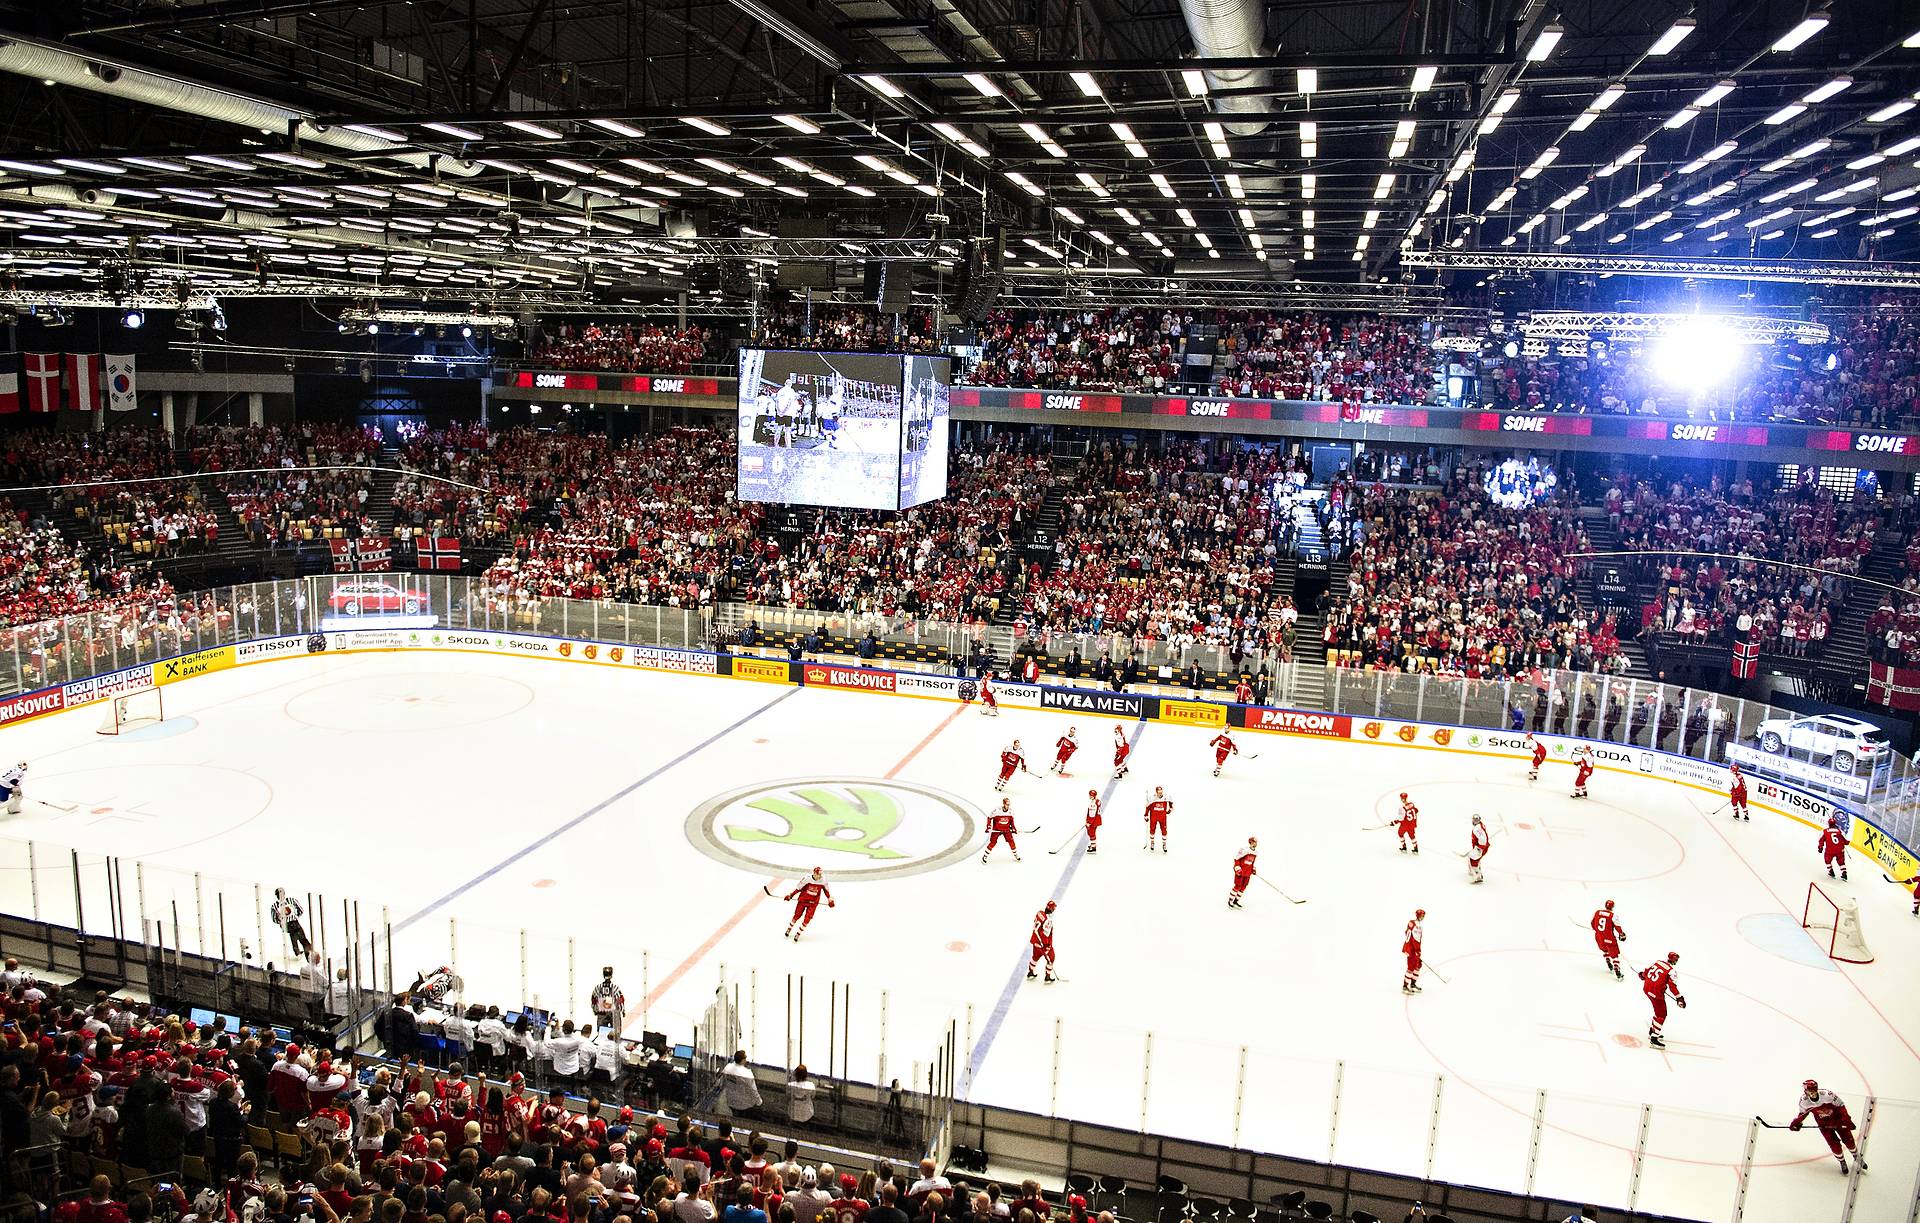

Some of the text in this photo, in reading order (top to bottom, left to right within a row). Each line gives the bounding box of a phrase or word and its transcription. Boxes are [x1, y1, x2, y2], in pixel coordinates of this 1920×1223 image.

[536, 374, 566, 388] SOME
[653, 379, 684, 392] SOME
[1046, 396, 1082, 410] SOME
[1190, 402, 1229, 416] SOME
[1503, 416, 1546, 432] SOME
[1672, 424, 1716, 441] SOME
[1856, 435, 1907, 453] SOME
[1306, 554, 1321, 562] L13
[1604, 575, 1620, 583] L14
[257, 639, 302, 652] TISSOT
[182, 650, 224, 664] Raiffeisen
[183, 663, 208, 676] BANK
[738, 662, 783, 677] PIRELLI
[97, 673, 122, 688] LIQUI
[127, 676, 152, 690] MOLY
[830, 669, 893, 689] KRUŠOVICE
[915, 680, 954, 689] TISSOT
[67, 681, 93, 696] LIQUI
[98, 684, 124, 698] MOLY
[67, 692, 94, 706] MOLY
[1044, 692, 1139, 713] NIVEA MEN
[1166, 704, 1220, 721] PIRELLI
[1262, 711, 1334, 730] PATRON
[1707, 776, 1722, 785] App
[1780, 790, 1829, 816] TISSOT
[1831, 833, 1839, 844] 6
[1880, 834, 1910, 867] Raiffeisen
[1878, 849, 1897, 871] BANK
[1598, 918, 1606, 931] 9
[1648, 965, 1664, 982] 25
